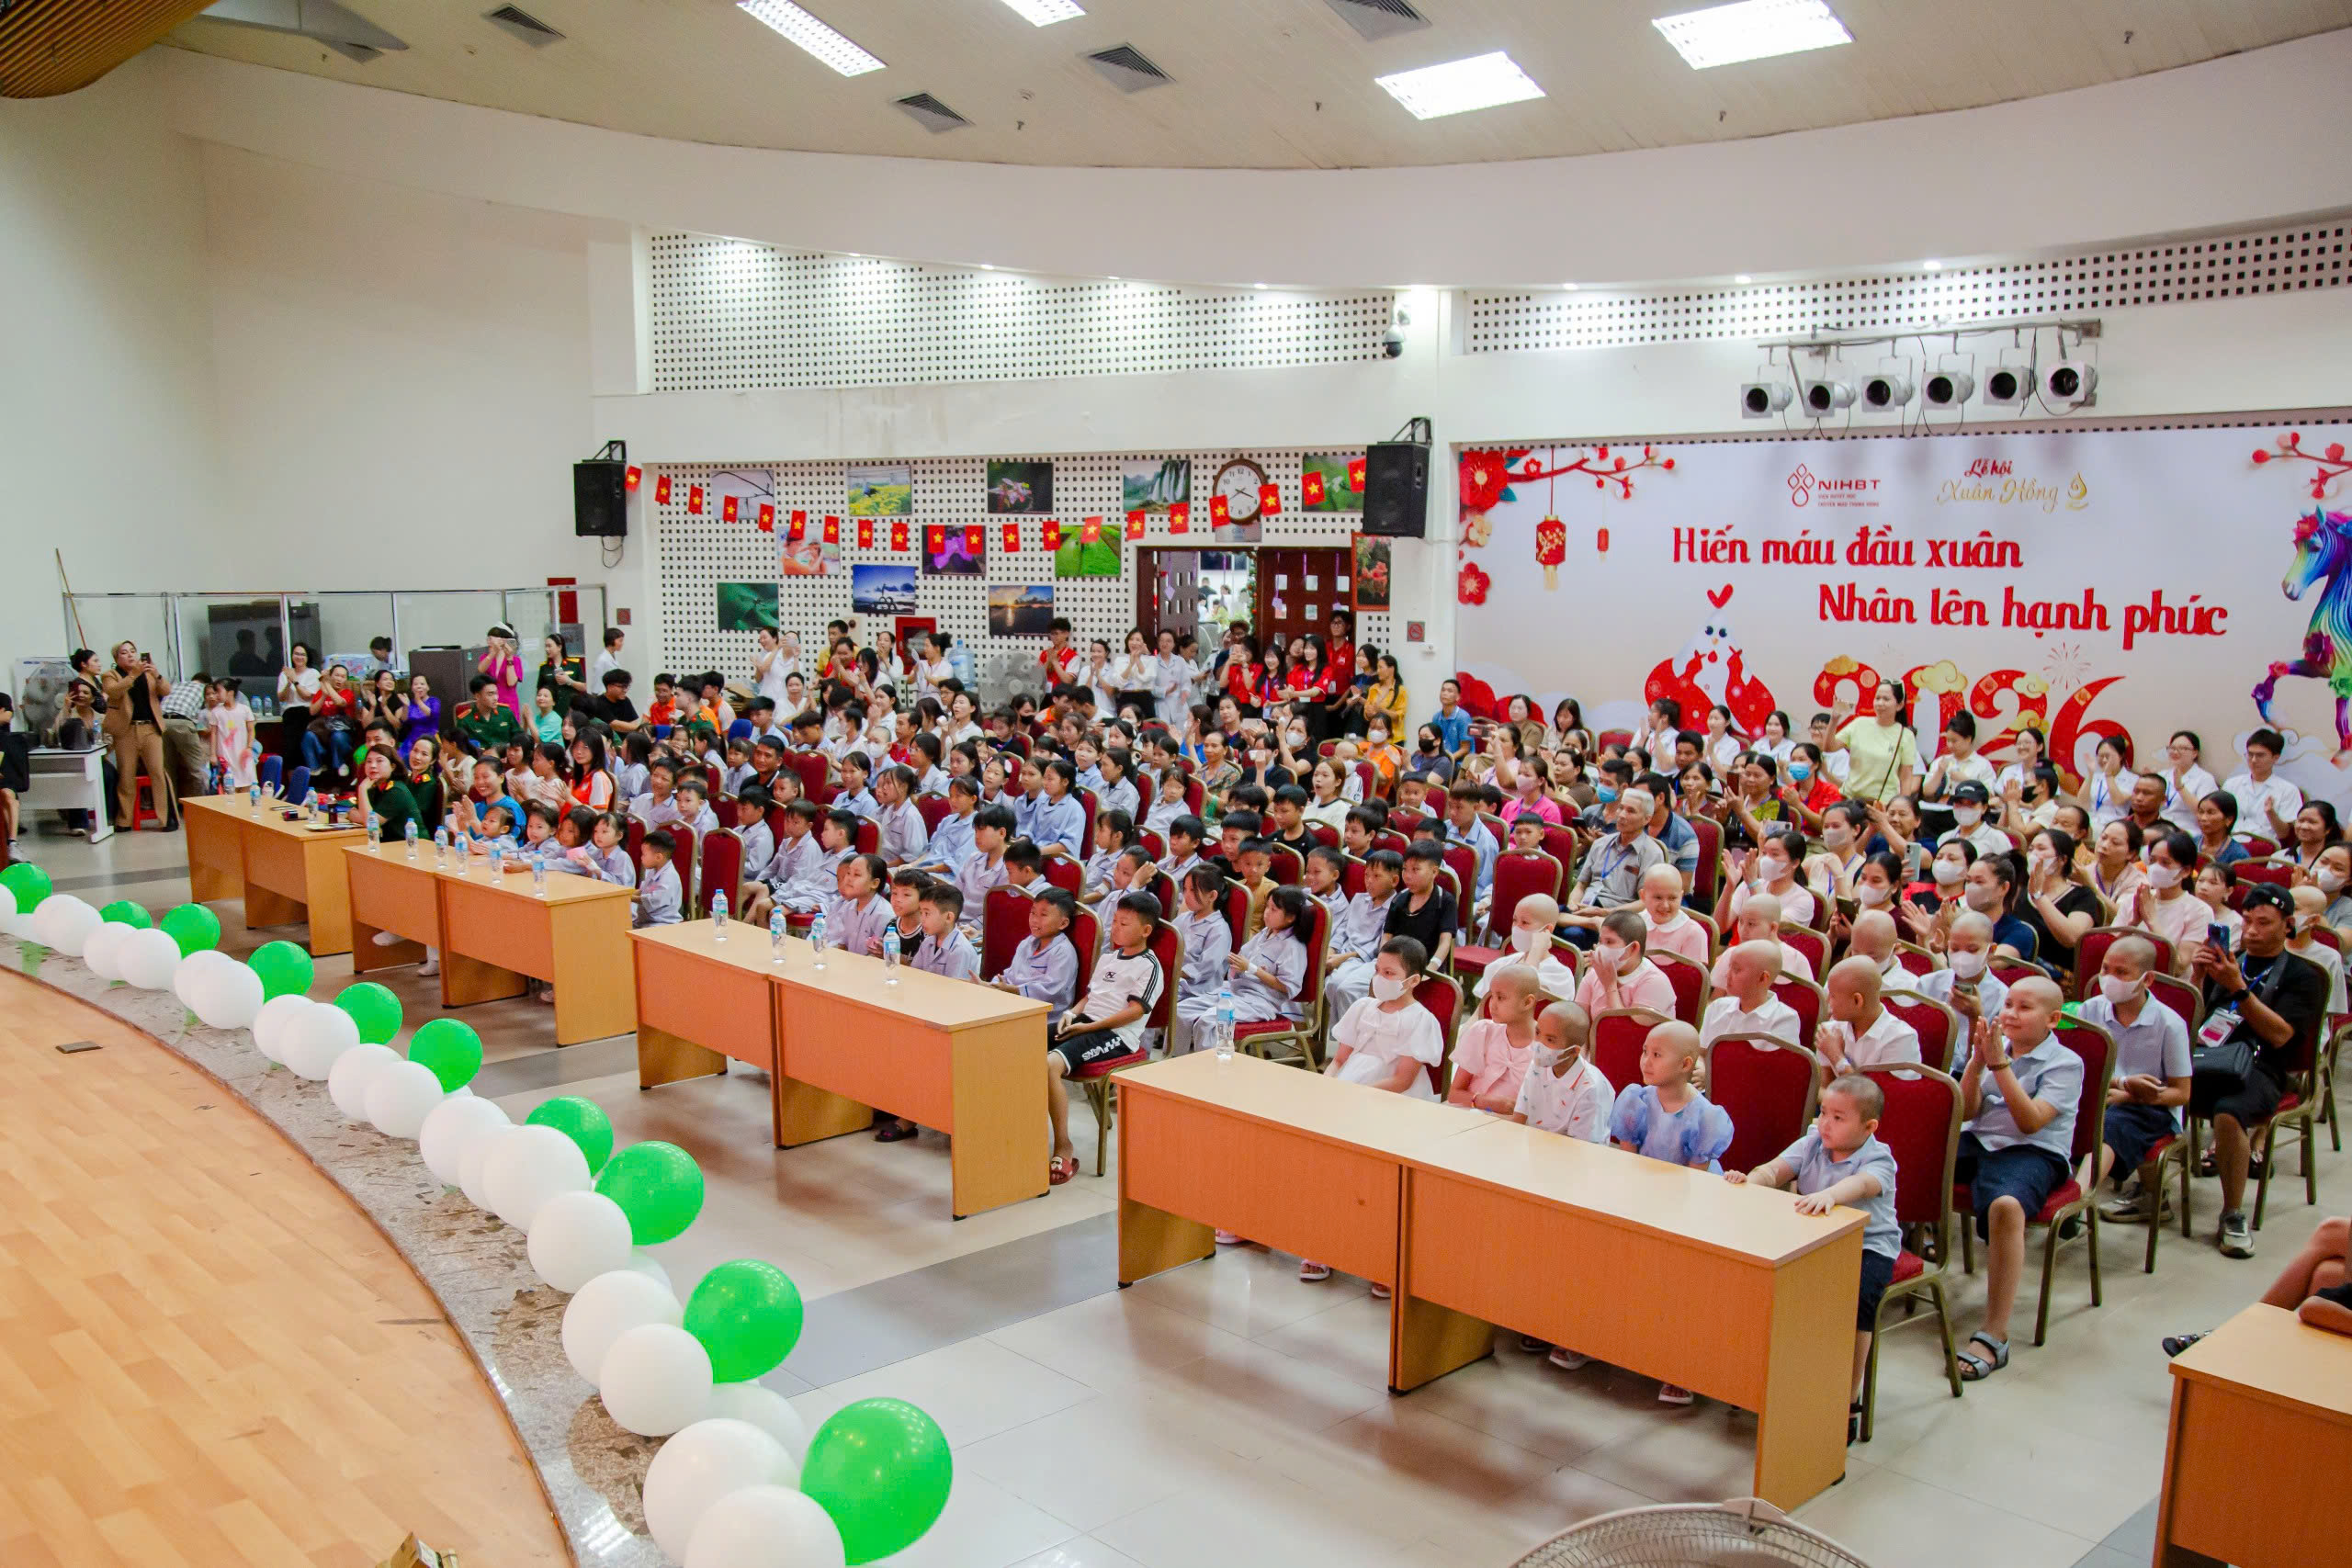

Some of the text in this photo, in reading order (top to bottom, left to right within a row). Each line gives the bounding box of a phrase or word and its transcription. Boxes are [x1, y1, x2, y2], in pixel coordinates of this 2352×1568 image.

[1818, 479, 1881, 491] NIHBT
[1963, 458, 2013, 478] Lễ hội
[1936, 477, 2059, 513] Xuân Hồng
[1673, 525, 2024, 569] Hiến máu đầu xuân
[1819, 581, 2229, 651] Nhân lên hạnh phúc
[1814, 661, 2134, 786] 2026
